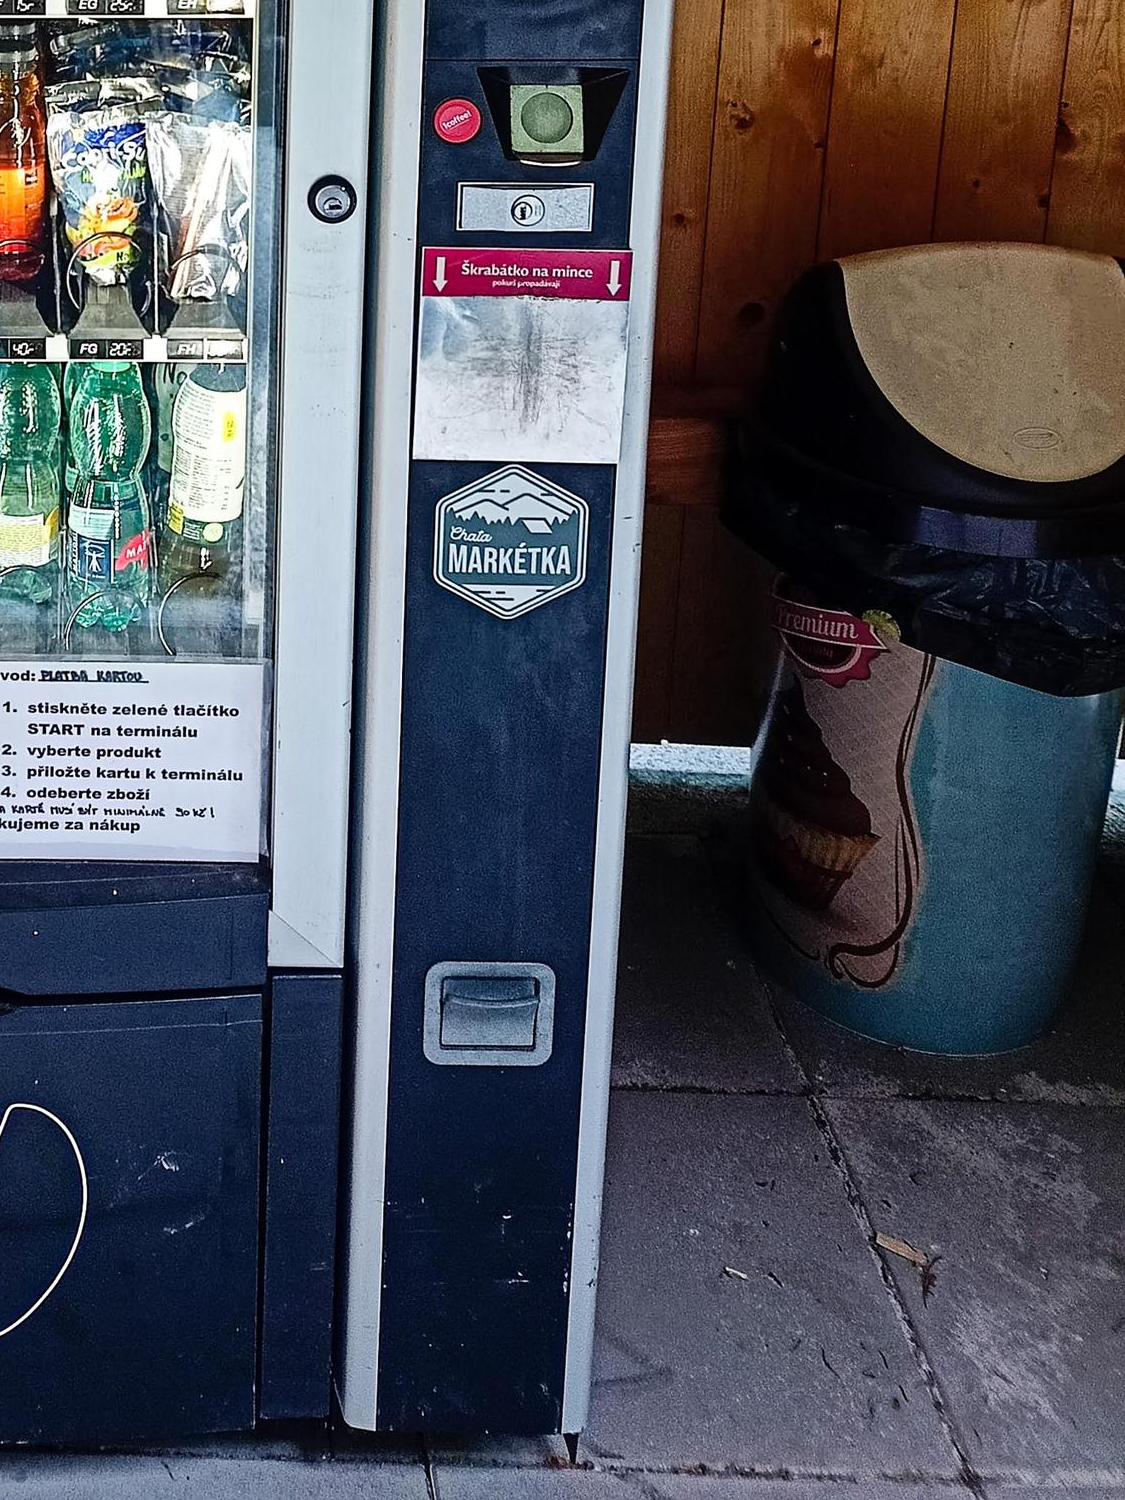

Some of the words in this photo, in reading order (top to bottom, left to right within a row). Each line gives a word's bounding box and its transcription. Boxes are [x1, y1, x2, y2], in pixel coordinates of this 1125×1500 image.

[461, 260, 529, 276] Škrabátko
[532, 266, 549, 276] na
[552, 265, 594, 278] mince
[79, 343, 98, 354] FG
[450, 526, 492, 543] Chata
[448, 542, 571, 575] MARKÉTKA
[2, 702, 18, 714] 1.
[27, 702, 107, 716] stiskněte
[112, 703, 168, 716] zelené
[173, 704, 240, 717] tlačítko
[27, 724, 84, 736] START
[90, 726, 111, 737] na
[117, 725, 198, 738] terminálu
[1, 744, 17, 756] 2.
[26, 745, 91, 760] vyberte
[96, 746, 162, 761] produkt
[1, 765, 17, 777] 3.
[26, 766, 91, 781] přiložte
[96, 767, 141, 780] kartu
[145, 768, 155, 780] k
[161, 768, 244, 782] terminálu
[0, 787, 17, 798] 4.
[26, 787, 102, 800] odeberte
[107, 788, 150, 801] zboží
[64, 821, 84, 830] za
[89, 818, 141, 833] nákup
